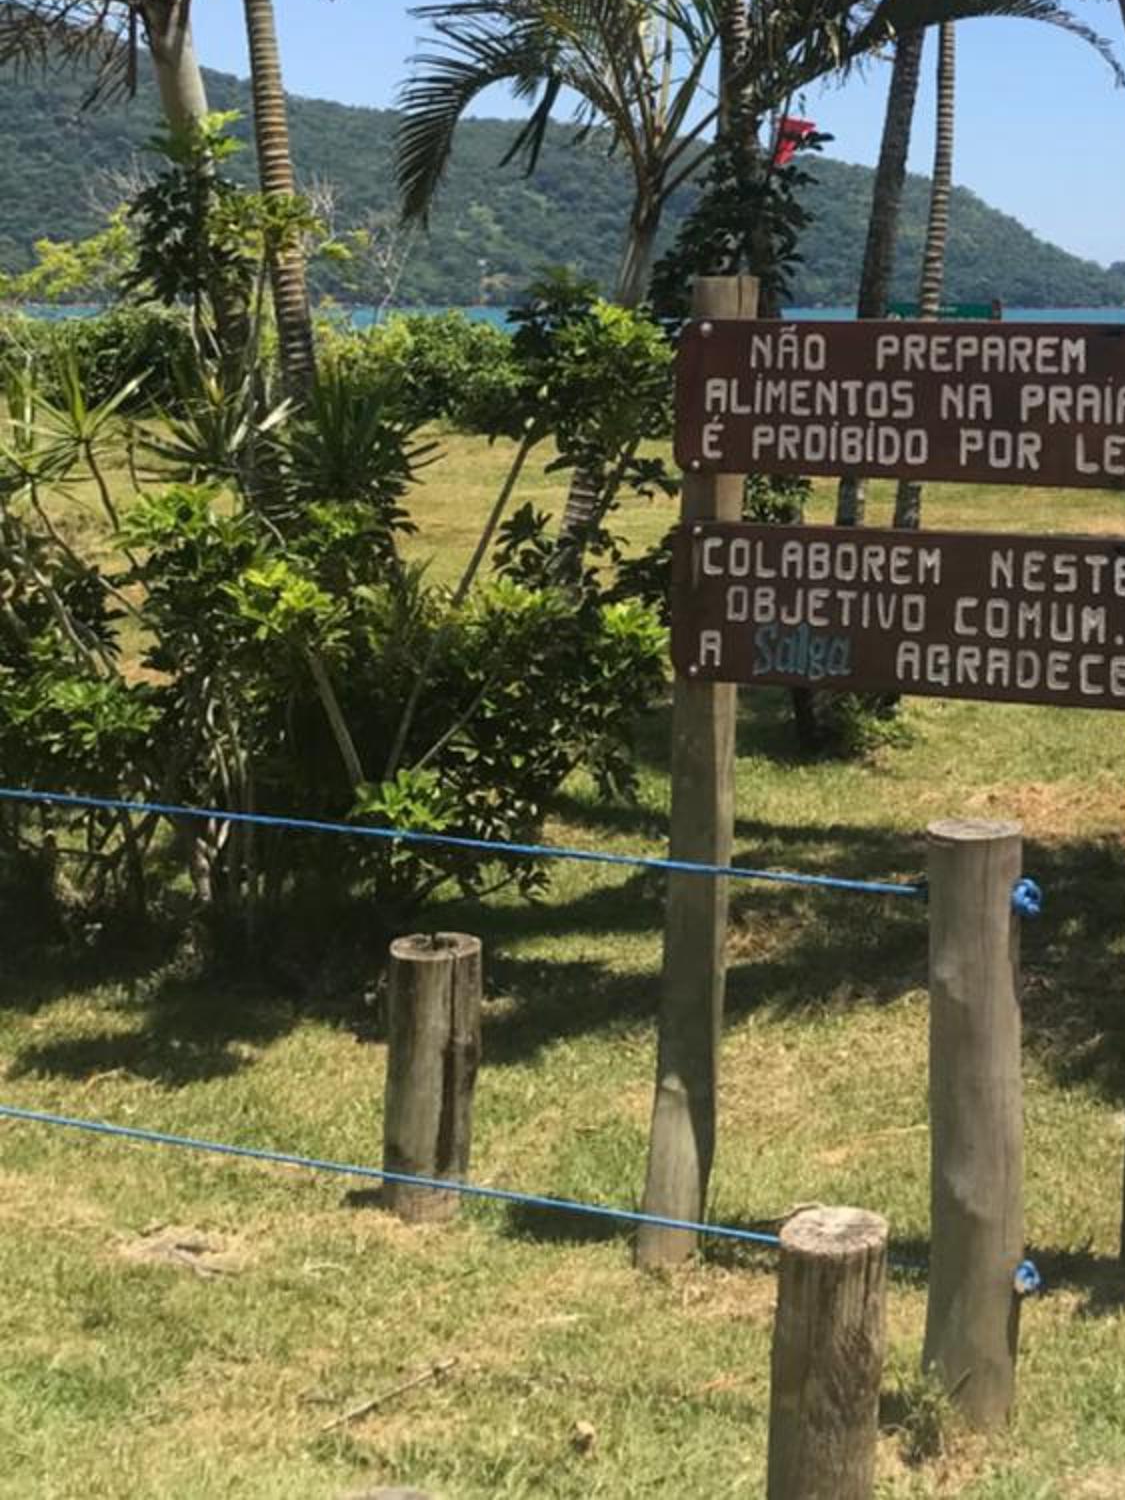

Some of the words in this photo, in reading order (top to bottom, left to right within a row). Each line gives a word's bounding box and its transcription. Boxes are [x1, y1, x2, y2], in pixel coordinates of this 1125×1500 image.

[750, 325, 826, 372] NÃO
[877, 334, 1086, 374] PREPAREM
[940, 385, 992, 420] NA
[702, 416, 724, 458] É
[959, 429, 1042, 470] POR
[702, 538, 941, 584] COLABOREM
[727, 587, 926, 631] OBJETIVO
[954, 598, 1125, 646] COMUM.
[700, 631, 721, 667] A
